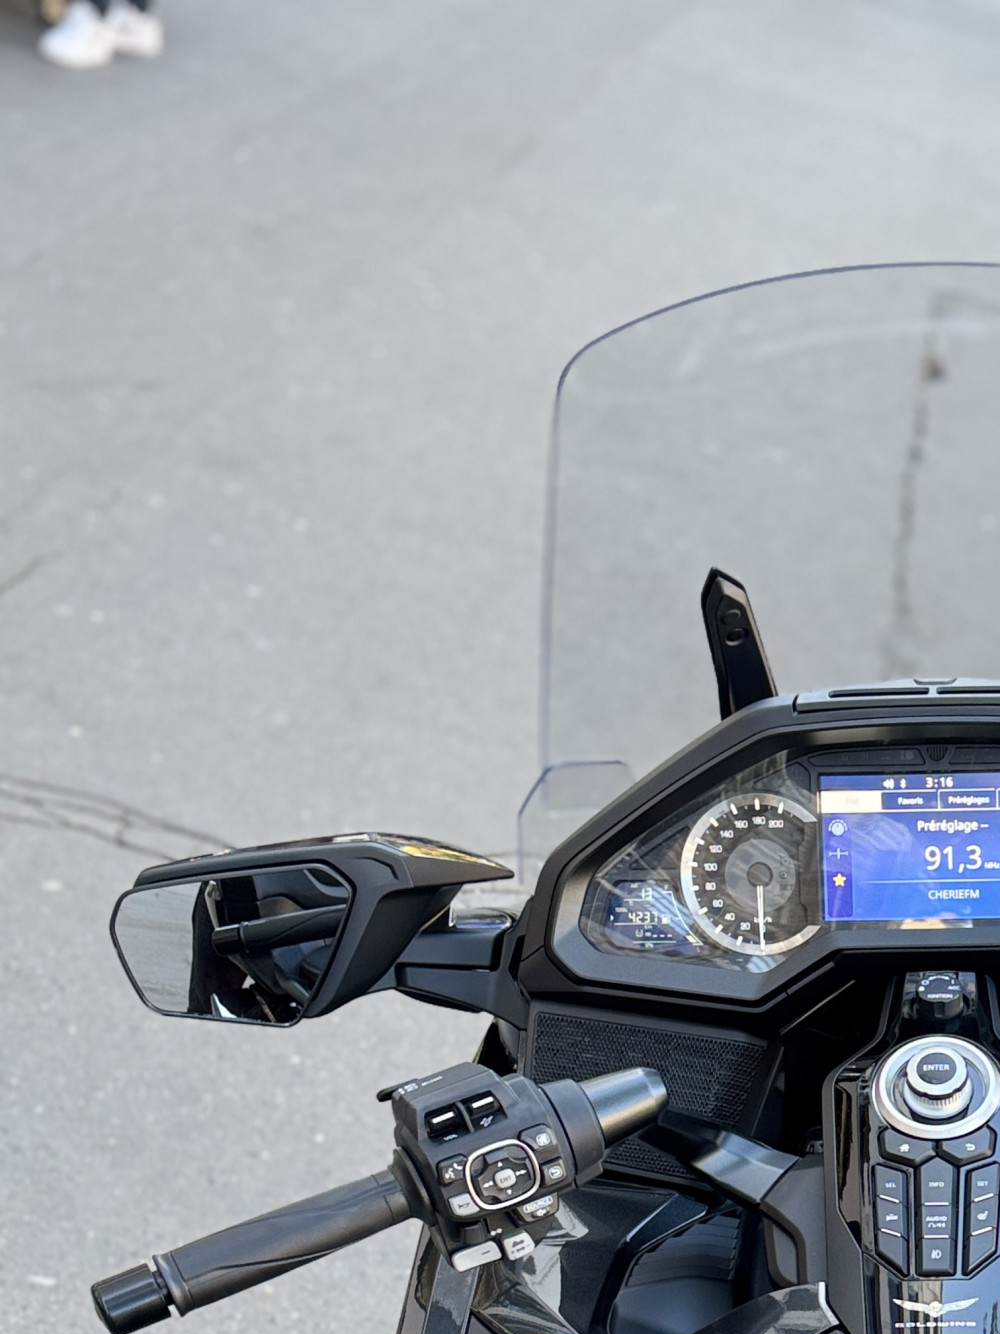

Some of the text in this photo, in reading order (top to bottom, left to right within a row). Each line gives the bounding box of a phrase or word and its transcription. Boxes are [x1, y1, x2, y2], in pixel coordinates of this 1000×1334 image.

[925, 776, 953, 788] 3:16
[898, 796, 923, 805] Favoris
[768, 819, 784, 829] 200
[917, 820, 978, 834] Préréglage
[720, 829, 734, 839] 140
[709, 844, 723, 854] 120
[924, 845, 982, 873] 91,3
[704, 862, 718, 872] 100
[928, 890, 980, 900] CHERIEFM
[628, 911, 658, 924] 4237
[725, 912, 736, 921] 40
[740, 921, 751, 931] 20
[922, 1064, 950, 1072] ENTER
